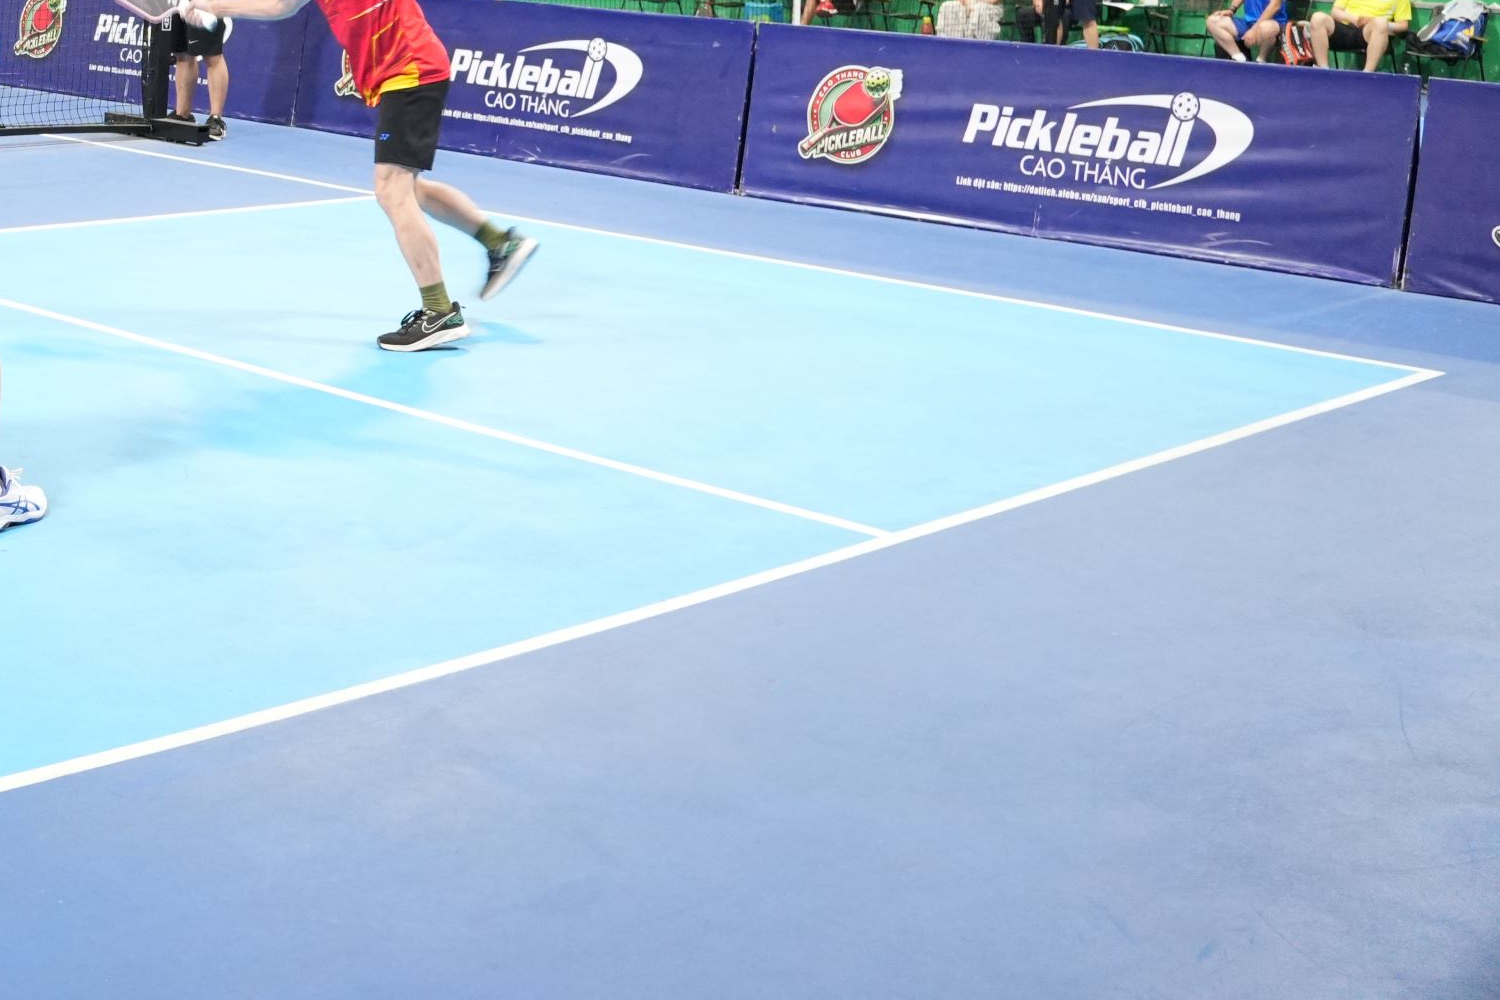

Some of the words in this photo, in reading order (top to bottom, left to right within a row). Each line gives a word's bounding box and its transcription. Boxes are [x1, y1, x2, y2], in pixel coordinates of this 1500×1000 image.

[120, 48, 142, 63] CAO
[450, 49, 604, 100] Pickleball
[819, 80, 834, 97] CAO
[836, 70, 864, 81] THANG
[484, 90, 516, 111] CAO
[520, 93, 570, 118] THẮNG
[816, 124, 885, 153] PICKLEBALL
[962, 103, 1196, 168] Pickleball
[840, 149, 862, 158] CLUB
[956, 175, 972, 186] Link
[973, 178, 986, 190] đặt
[986, 179, 1002, 191] sân:
[1019, 155, 1066, 179] CAO
[1072, 159, 1146, 190] THẮNG
